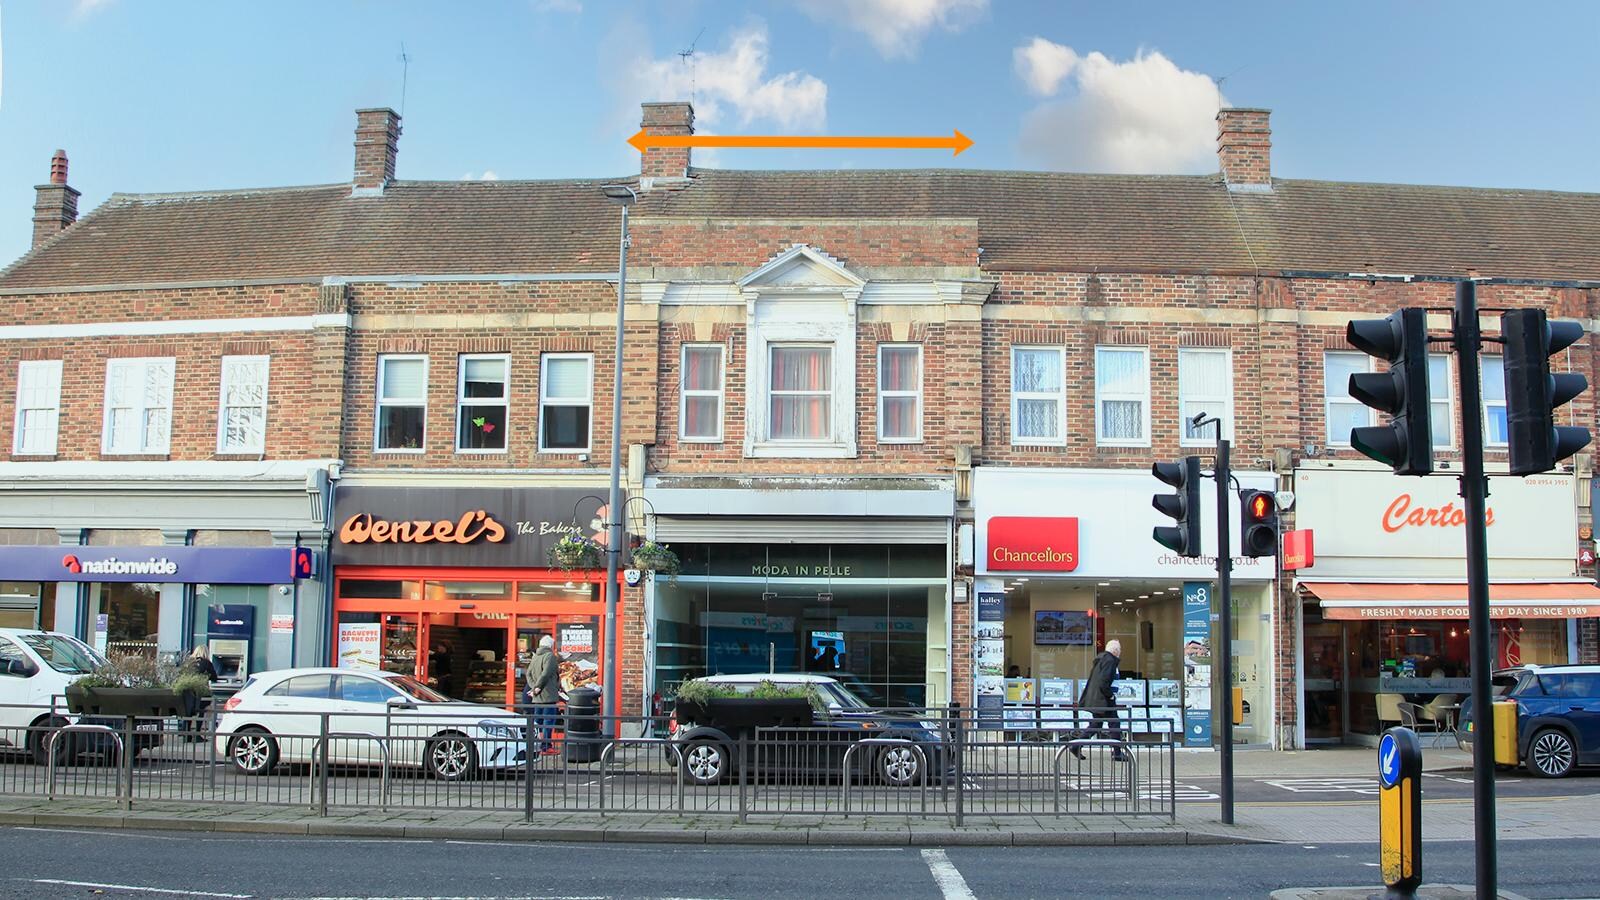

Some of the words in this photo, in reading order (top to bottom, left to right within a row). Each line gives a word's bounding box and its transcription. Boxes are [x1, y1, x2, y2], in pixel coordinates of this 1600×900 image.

[1382, 493, 1495, 533] Cartos
[340, 509, 506, 545] Wenzel's
[516, 521, 536, 534] The
[539, 522, 582, 536] Bakers
[993, 546, 1073, 563] Chancellors
[82, 556, 178, 576] nationwide
[752, 565, 789, 576] MODA
[796, 565, 809, 576] IN
[814, 565, 851, 576] PELLE
[980, 596, 1002, 605] halley
[1360, 608, 1405, 617] FRESHLY
[1408, 608, 1439, 617] MADE
[1441, 607, 1470, 616] FOOD
[1508, 607, 1530, 616] DAY
[1533, 607, 1563, 616] SINCE
[1566, 607, 1588, 616] 1989
[561, 645, 593, 653] ICONIC
